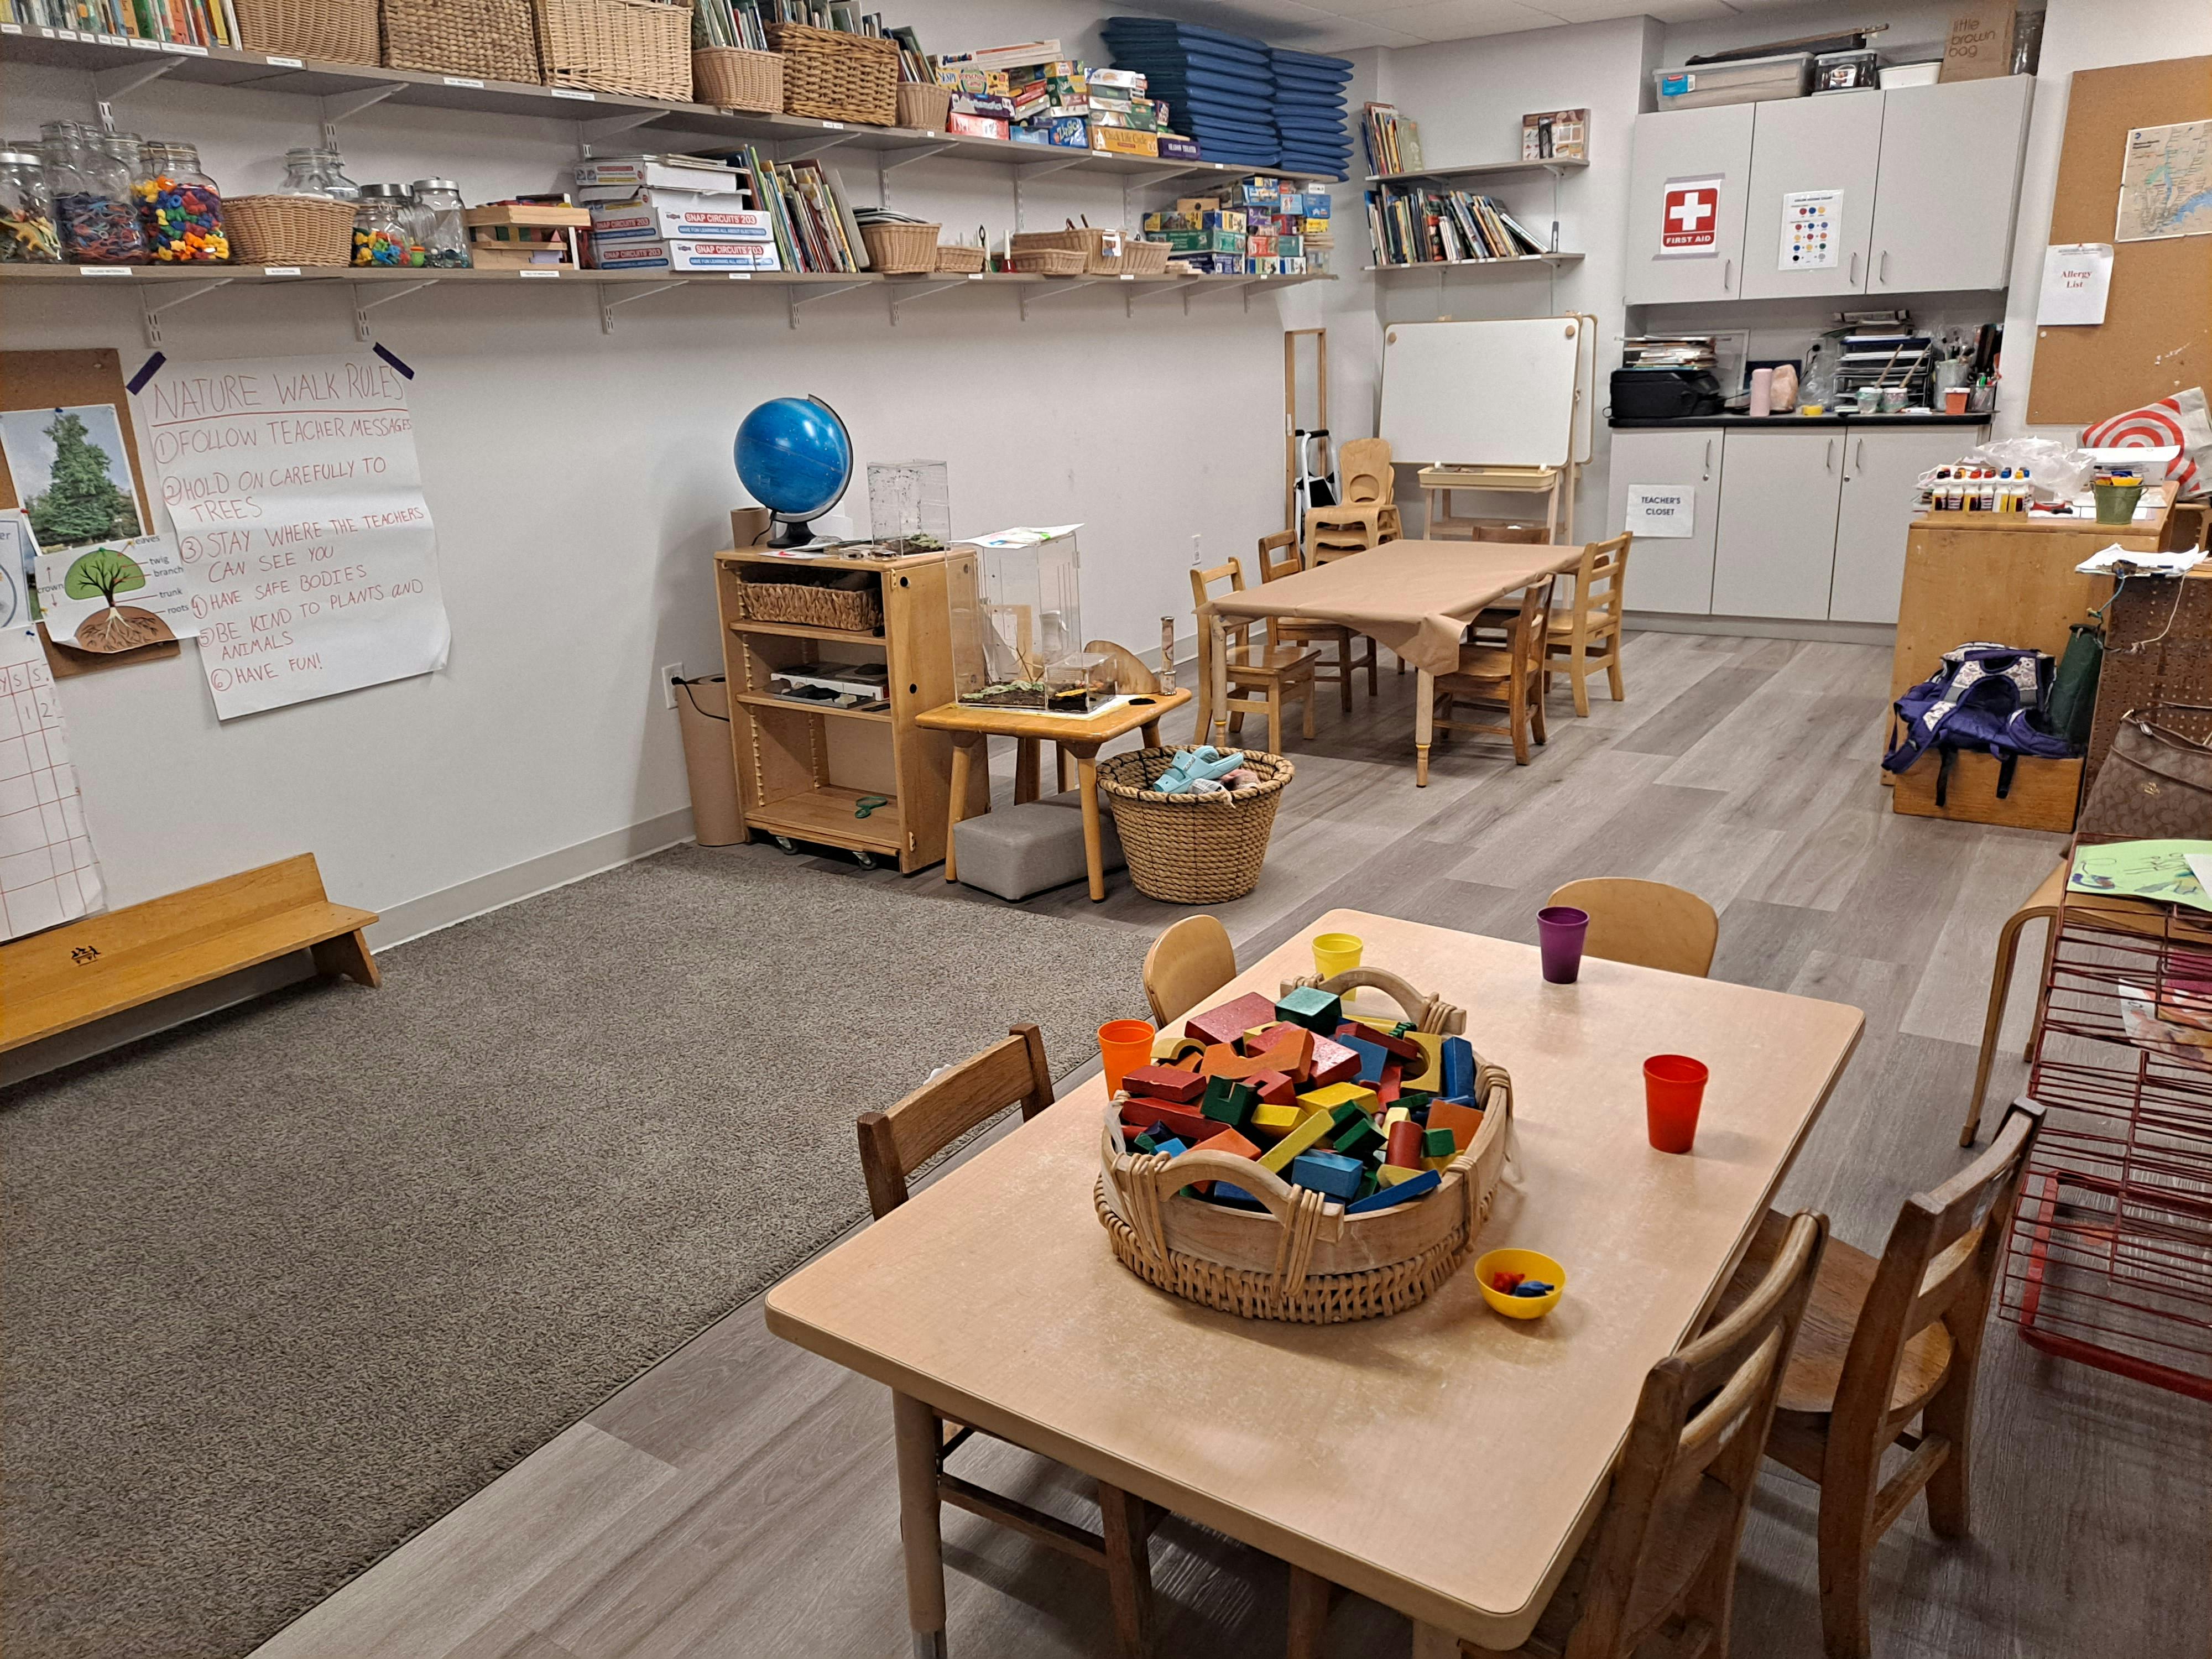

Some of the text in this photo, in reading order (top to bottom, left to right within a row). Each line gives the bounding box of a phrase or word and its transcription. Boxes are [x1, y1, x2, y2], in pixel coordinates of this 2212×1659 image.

[1953, 18, 1980, 32] little
[1951, 30, 1996, 45] brown
[1949, 44, 1978, 58] bag
[596, 221, 610, 229] SNAP
[611, 220, 636, 228] CIRCUITS
[686, 213, 706, 223] SNAP
[707, 214, 740, 224] CIRCUITS
[742, 215, 756, 225] 203
[1666, 236, 1693, 244] FIRST
[620, 249, 647, 258] CIRCUITS
[648, 248, 661, 256] 203
[716, 246, 747, 254] CIRCUITS
[2061, 270, 2093, 279] Allergy
[154, 363, 403, 419] NATURE WALK RULES
[179, 427, 257, 456] FOLLOW
[267, 418, 345, 444] TEACHER
[350, 418, 412, 437] MESSAGES
[182, 472, 229, 500] HOLD
[239, 471, 263, 491] ON
[270, 460, 354, 487] CAREFULLY
[362, 457, 386, 474] TO
[1641, 496, 1681, 504] TEACHER'S
[190, 496, 262, 522] TREES
[207, 530, 250, 558] STAY
[265, 522, 322, 546] WHERE
[328, 518, 358, 535] THE
[362, 507, 424, 529] TEACHERS
[149, 556, 169, 565] twig
[208, 546, 333, 583] CAN SEE YOU
[153, 567, 184, 577] branch
[37, 584, 64, 594] crown
[159, 588, 183, 597] trunk
[210, 590, 242, 610] HAVE
[255, 580, 290, 600] SAFE
[300, 565, 367, 592] BODIES
[167, 603, 189, 614] roots
[215, 622, 242, 643] BE
[249, 608, 291, 633] KIND
[299, 602, 320, 618] TO
[330, 585, 384, 609] PLANTS
[222, 631, 293, 661] ANIMALS
[234, 663, 279, 684] HAVE
[289, 652, 323, 671] FUN!
[40, 702, 53, 718] 2
